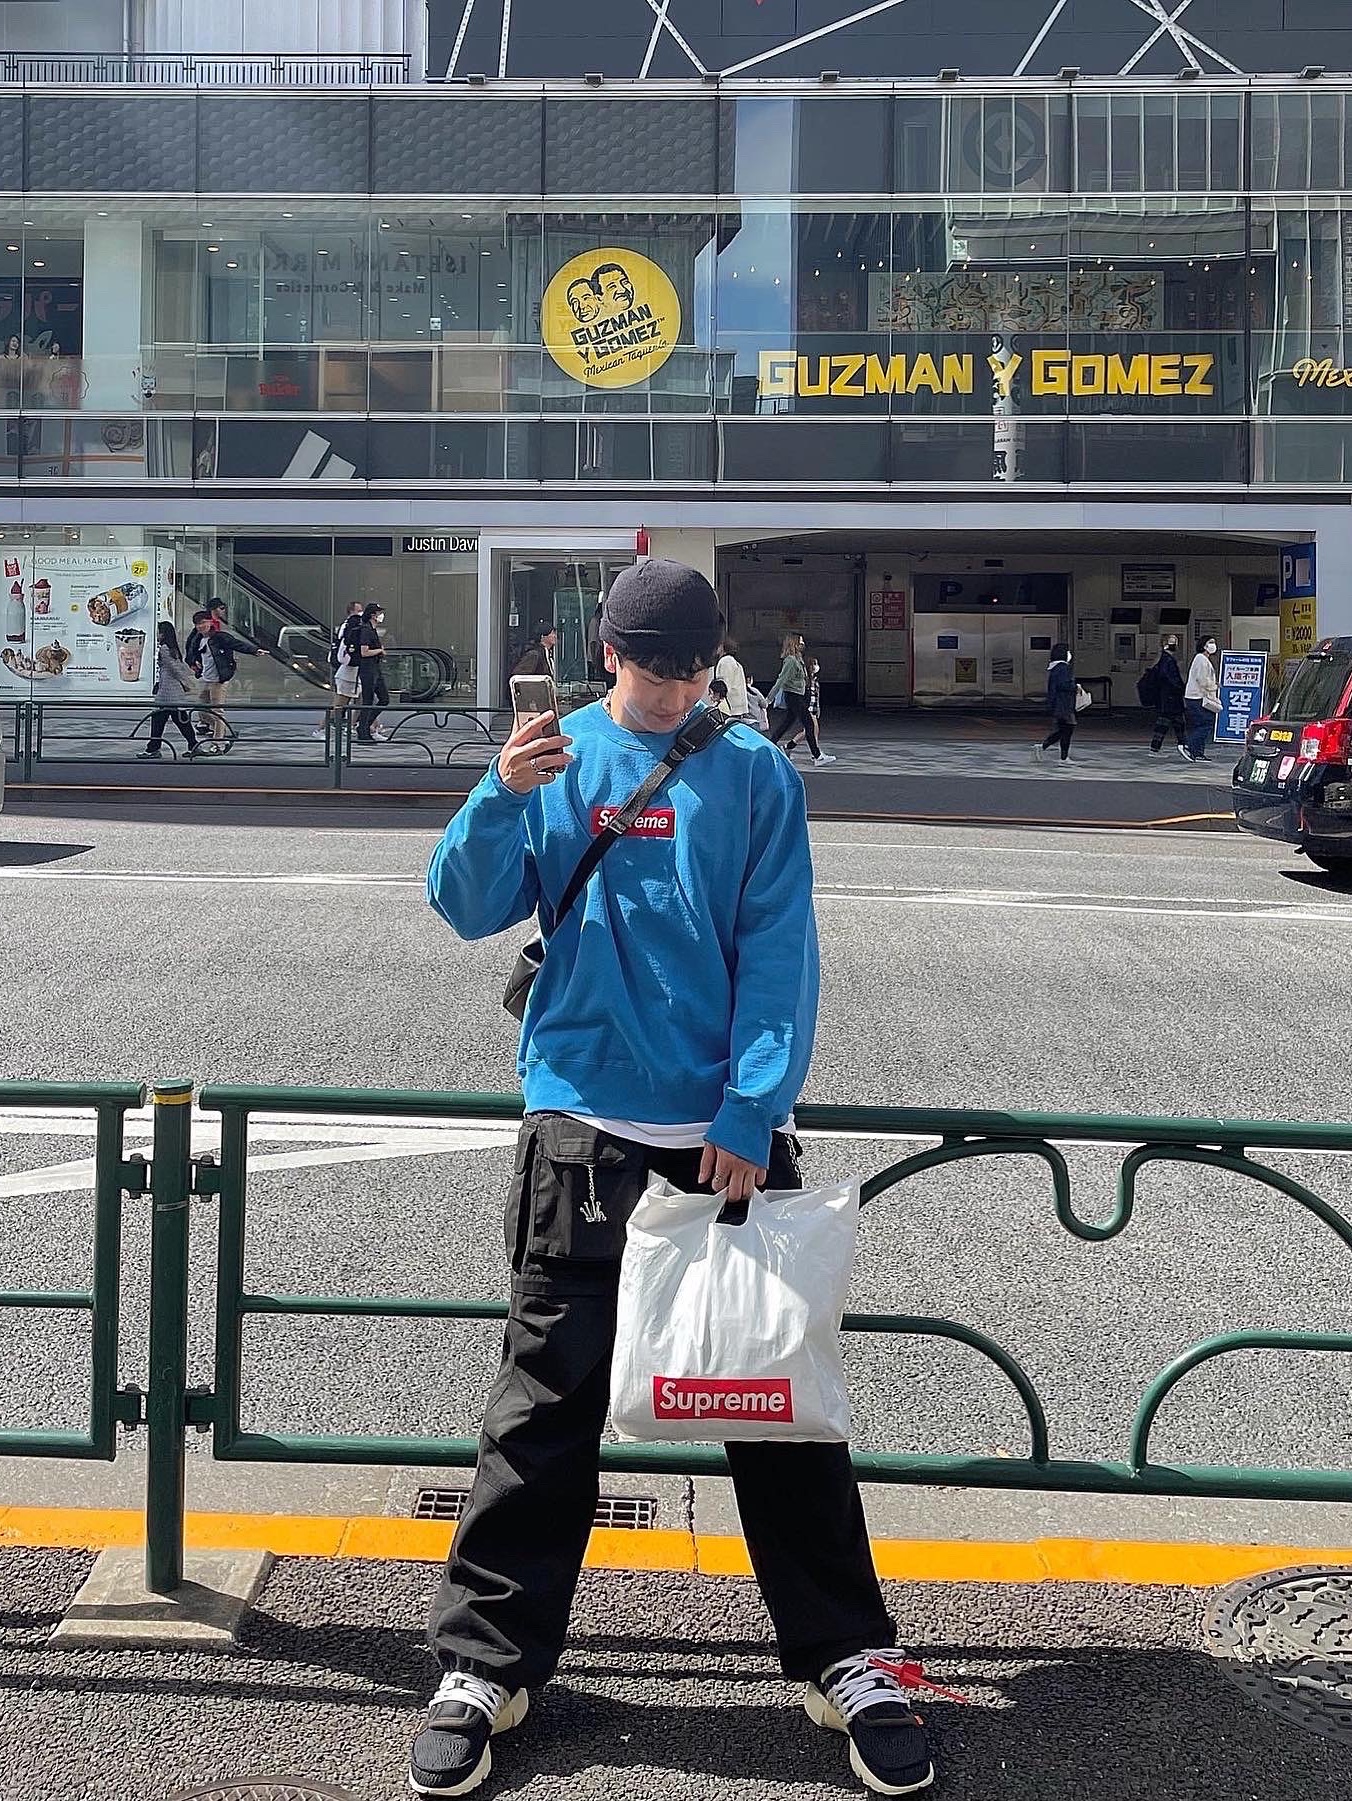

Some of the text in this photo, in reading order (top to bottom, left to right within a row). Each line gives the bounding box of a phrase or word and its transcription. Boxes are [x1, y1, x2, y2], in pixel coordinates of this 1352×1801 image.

[571, 304, 652, 345] GUZMAN
[578, 346, 590, 363] Y
[583, 357, 625, 378] Mexican
[758, 350, 1214, 397] GUZMAN Y GOMEZ
[407, 536, 446, 551] Justin
[84, 557, 119, 565] MARKET
[1226, 689, 1252, 735] 空車
[598, 809, 669, 830] Seme
[660, 1381, 786, 1417] Supreme
